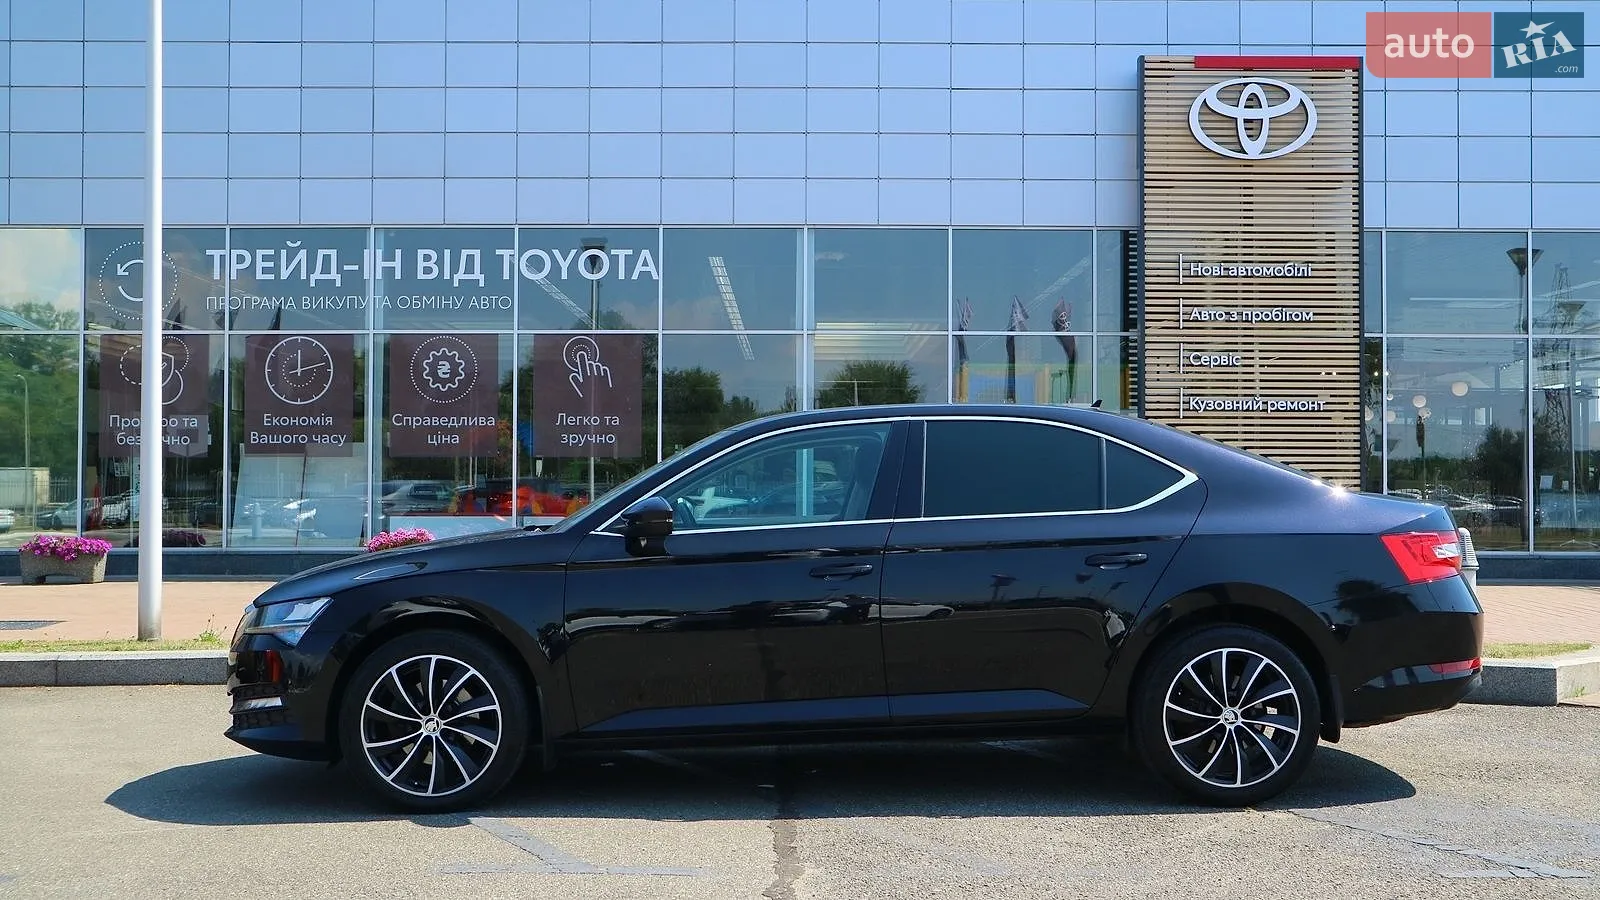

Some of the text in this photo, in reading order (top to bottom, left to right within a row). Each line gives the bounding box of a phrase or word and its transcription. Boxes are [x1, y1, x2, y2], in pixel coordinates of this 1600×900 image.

[205, 240, 660, 288] ТРЕЙД-ІН ВІД TOYOTA
[1189, 262, 1313, 278] Нові автомобілі
[206, 295, 512, 311] ПРОГРАМА ВИКУПУ ТА ОБМІНУ АВТО
[1189, 306, 1314, 325] Авто з пробігом
[1189, 352, 1242, 369] Сервіс
[1189, 396, 1327, 414] Кузовний ремонт
[182, 417, 198, 427] та
[263, 413, 334, 427] Економія
[391, 413, 496, 430] Справедлива
[555, 413, 620, 427] Легко та
[250, 431, 347, 448] Вашого часу
[427, 431, 460, 447] ціна
[560, 433, 616, 448] зручно
